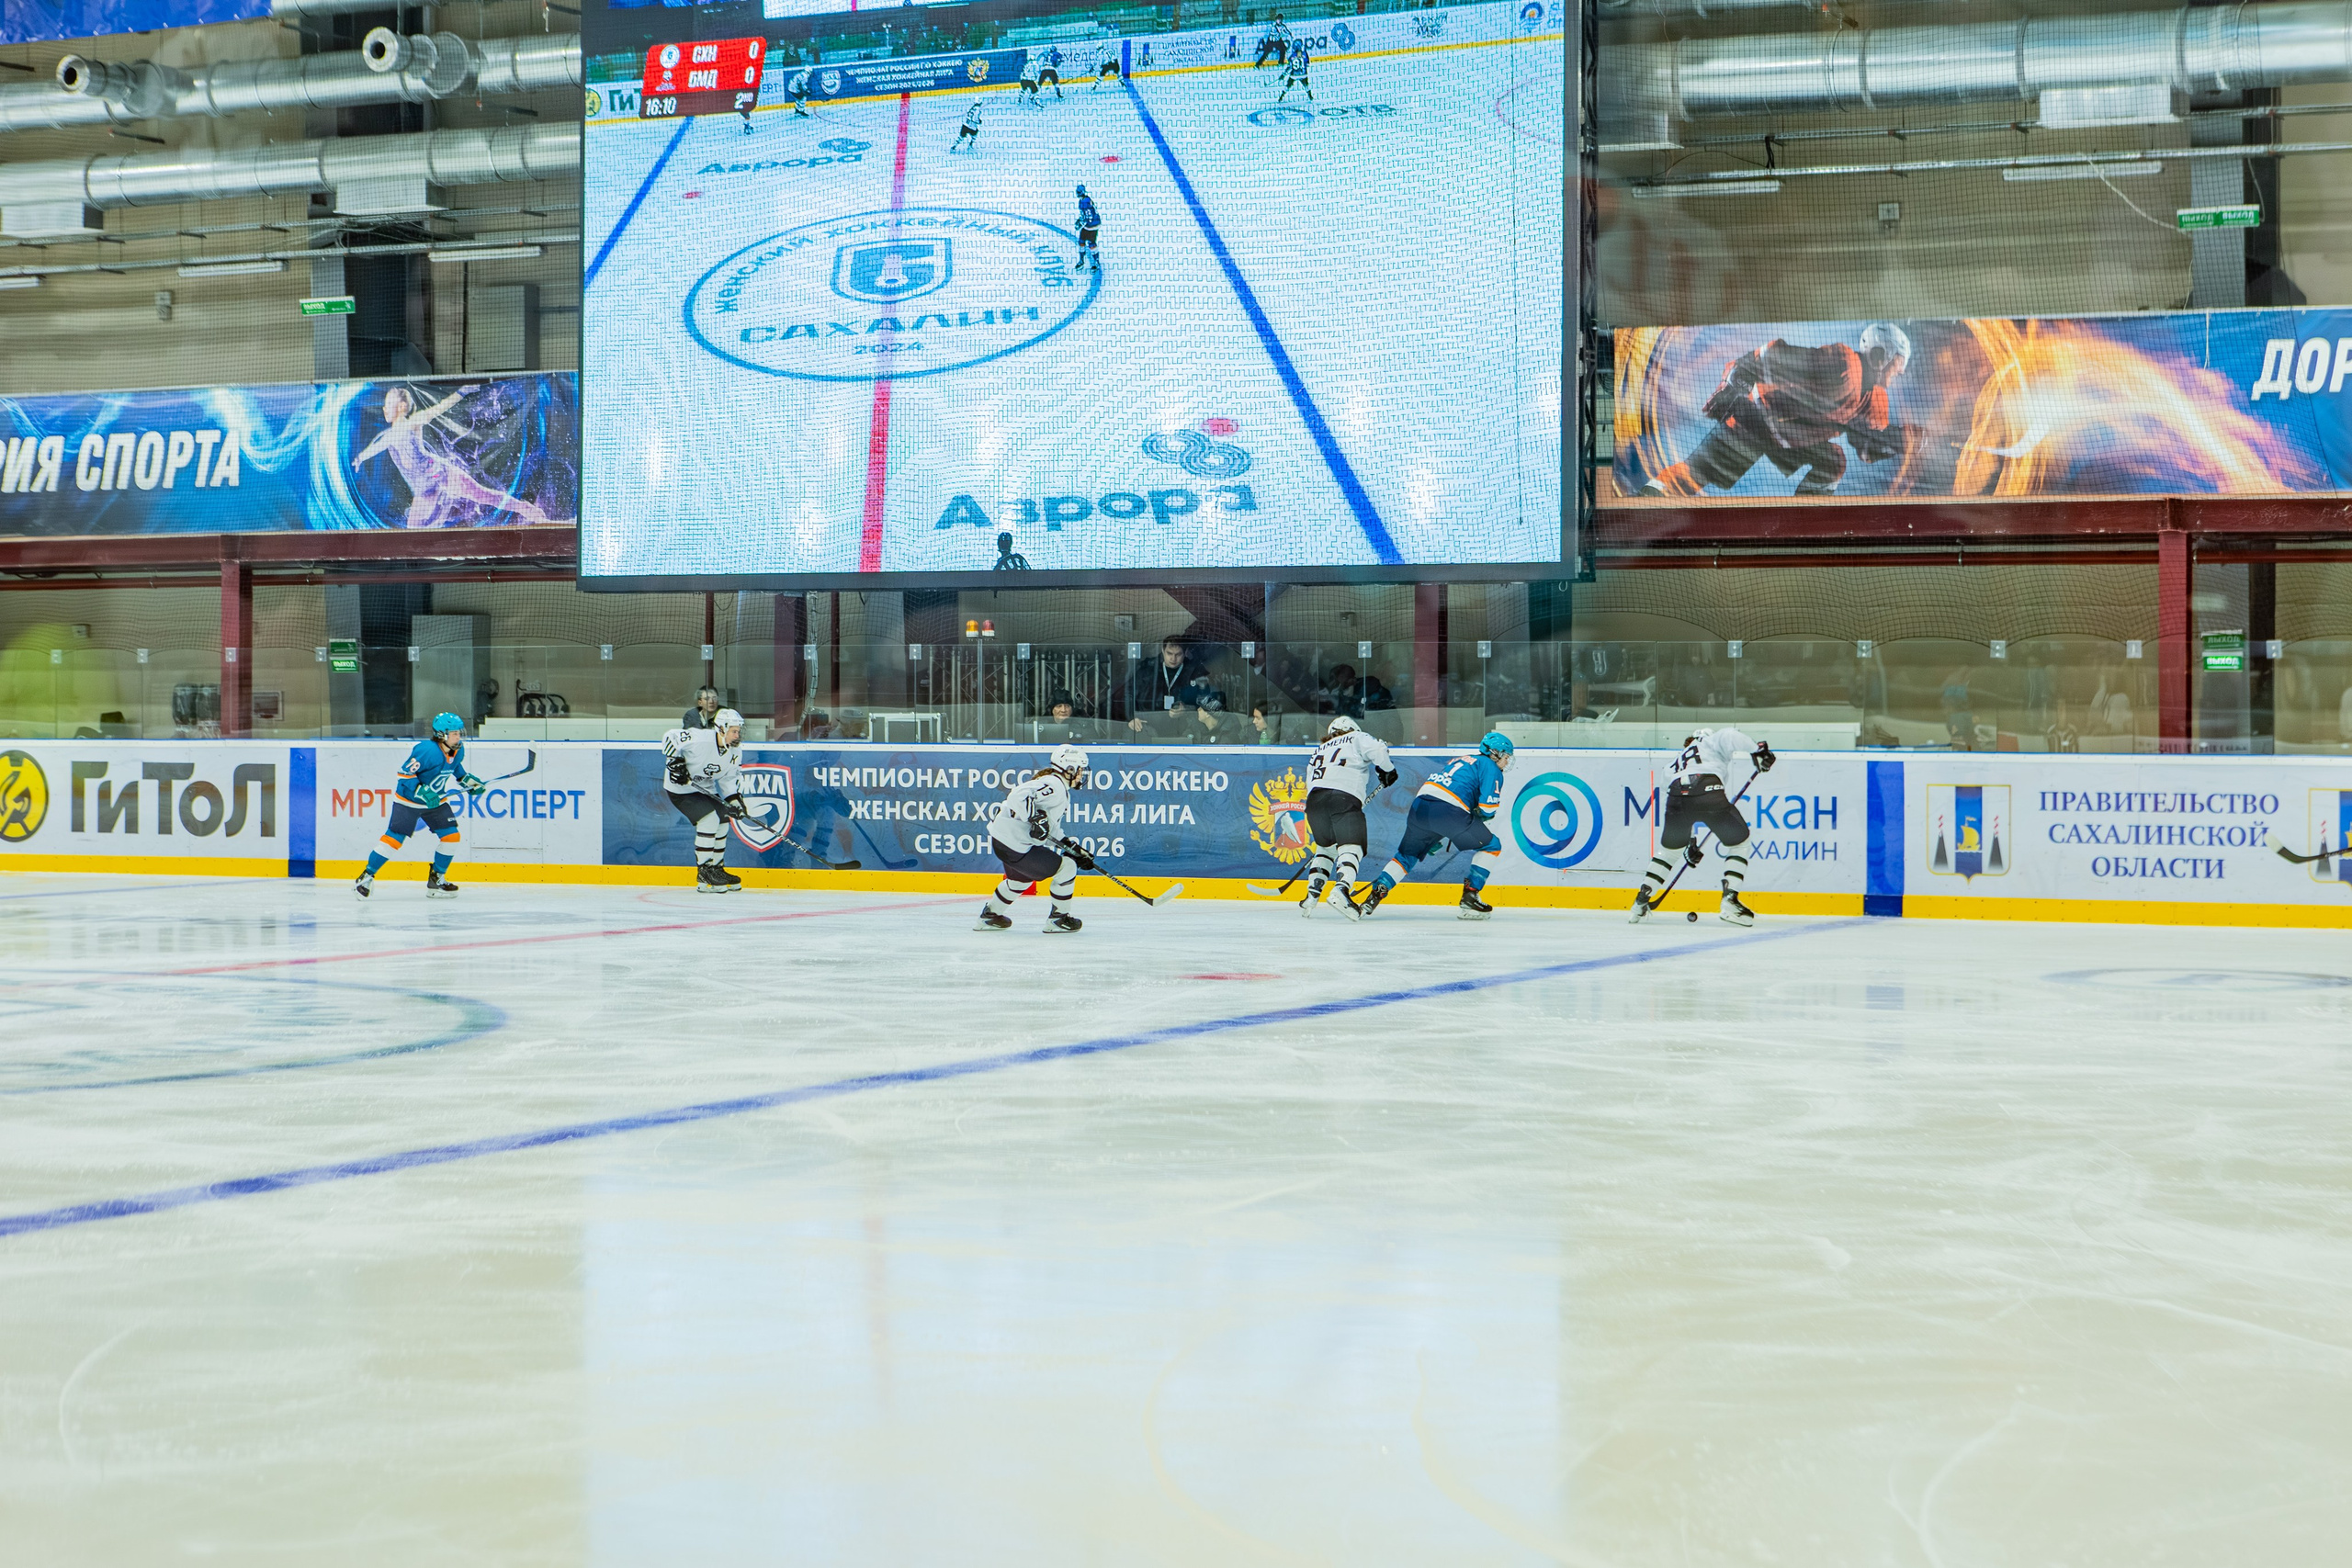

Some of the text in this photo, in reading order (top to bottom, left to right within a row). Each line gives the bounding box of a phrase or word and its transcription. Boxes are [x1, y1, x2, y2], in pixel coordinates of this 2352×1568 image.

[749, 41, 759, 59] 0
[745, 66, 755, 84] 0
[646, 96, 677, 117] 16:10
[740, 307, 1038, 344] САХАЛИН
[75, 429, 241, 491] СПОРТА
[737, 773, 786, 796] ЖХЛ
[813, 766, 963, 788] ЧЕМПИОНАТ
[967, 769, 1039, 790] РОСС
[1118, 769, 1229, 792] ХОККЕЮ
[70, 761, 277, 838] ГиТоЛ
[332, 788, 586, 820] МРТ ЭКСПЕРТ
[2039, 791, 2279, 815] ПРАВИТЕЛЬСТВО
[848, 799, 967, 821] ЖЕНСКАЯ
[1130, 804, 1196, 825] ЛИГА
[914, 833, 992, 854] СЕЗОН
[2048, 821, 2270, 847] САХАЛИНСКОЙ
[1715, 840, 1838, 861] СХАЛИН
[2091, 856, 2225, 879] ОБЛАСТИ
